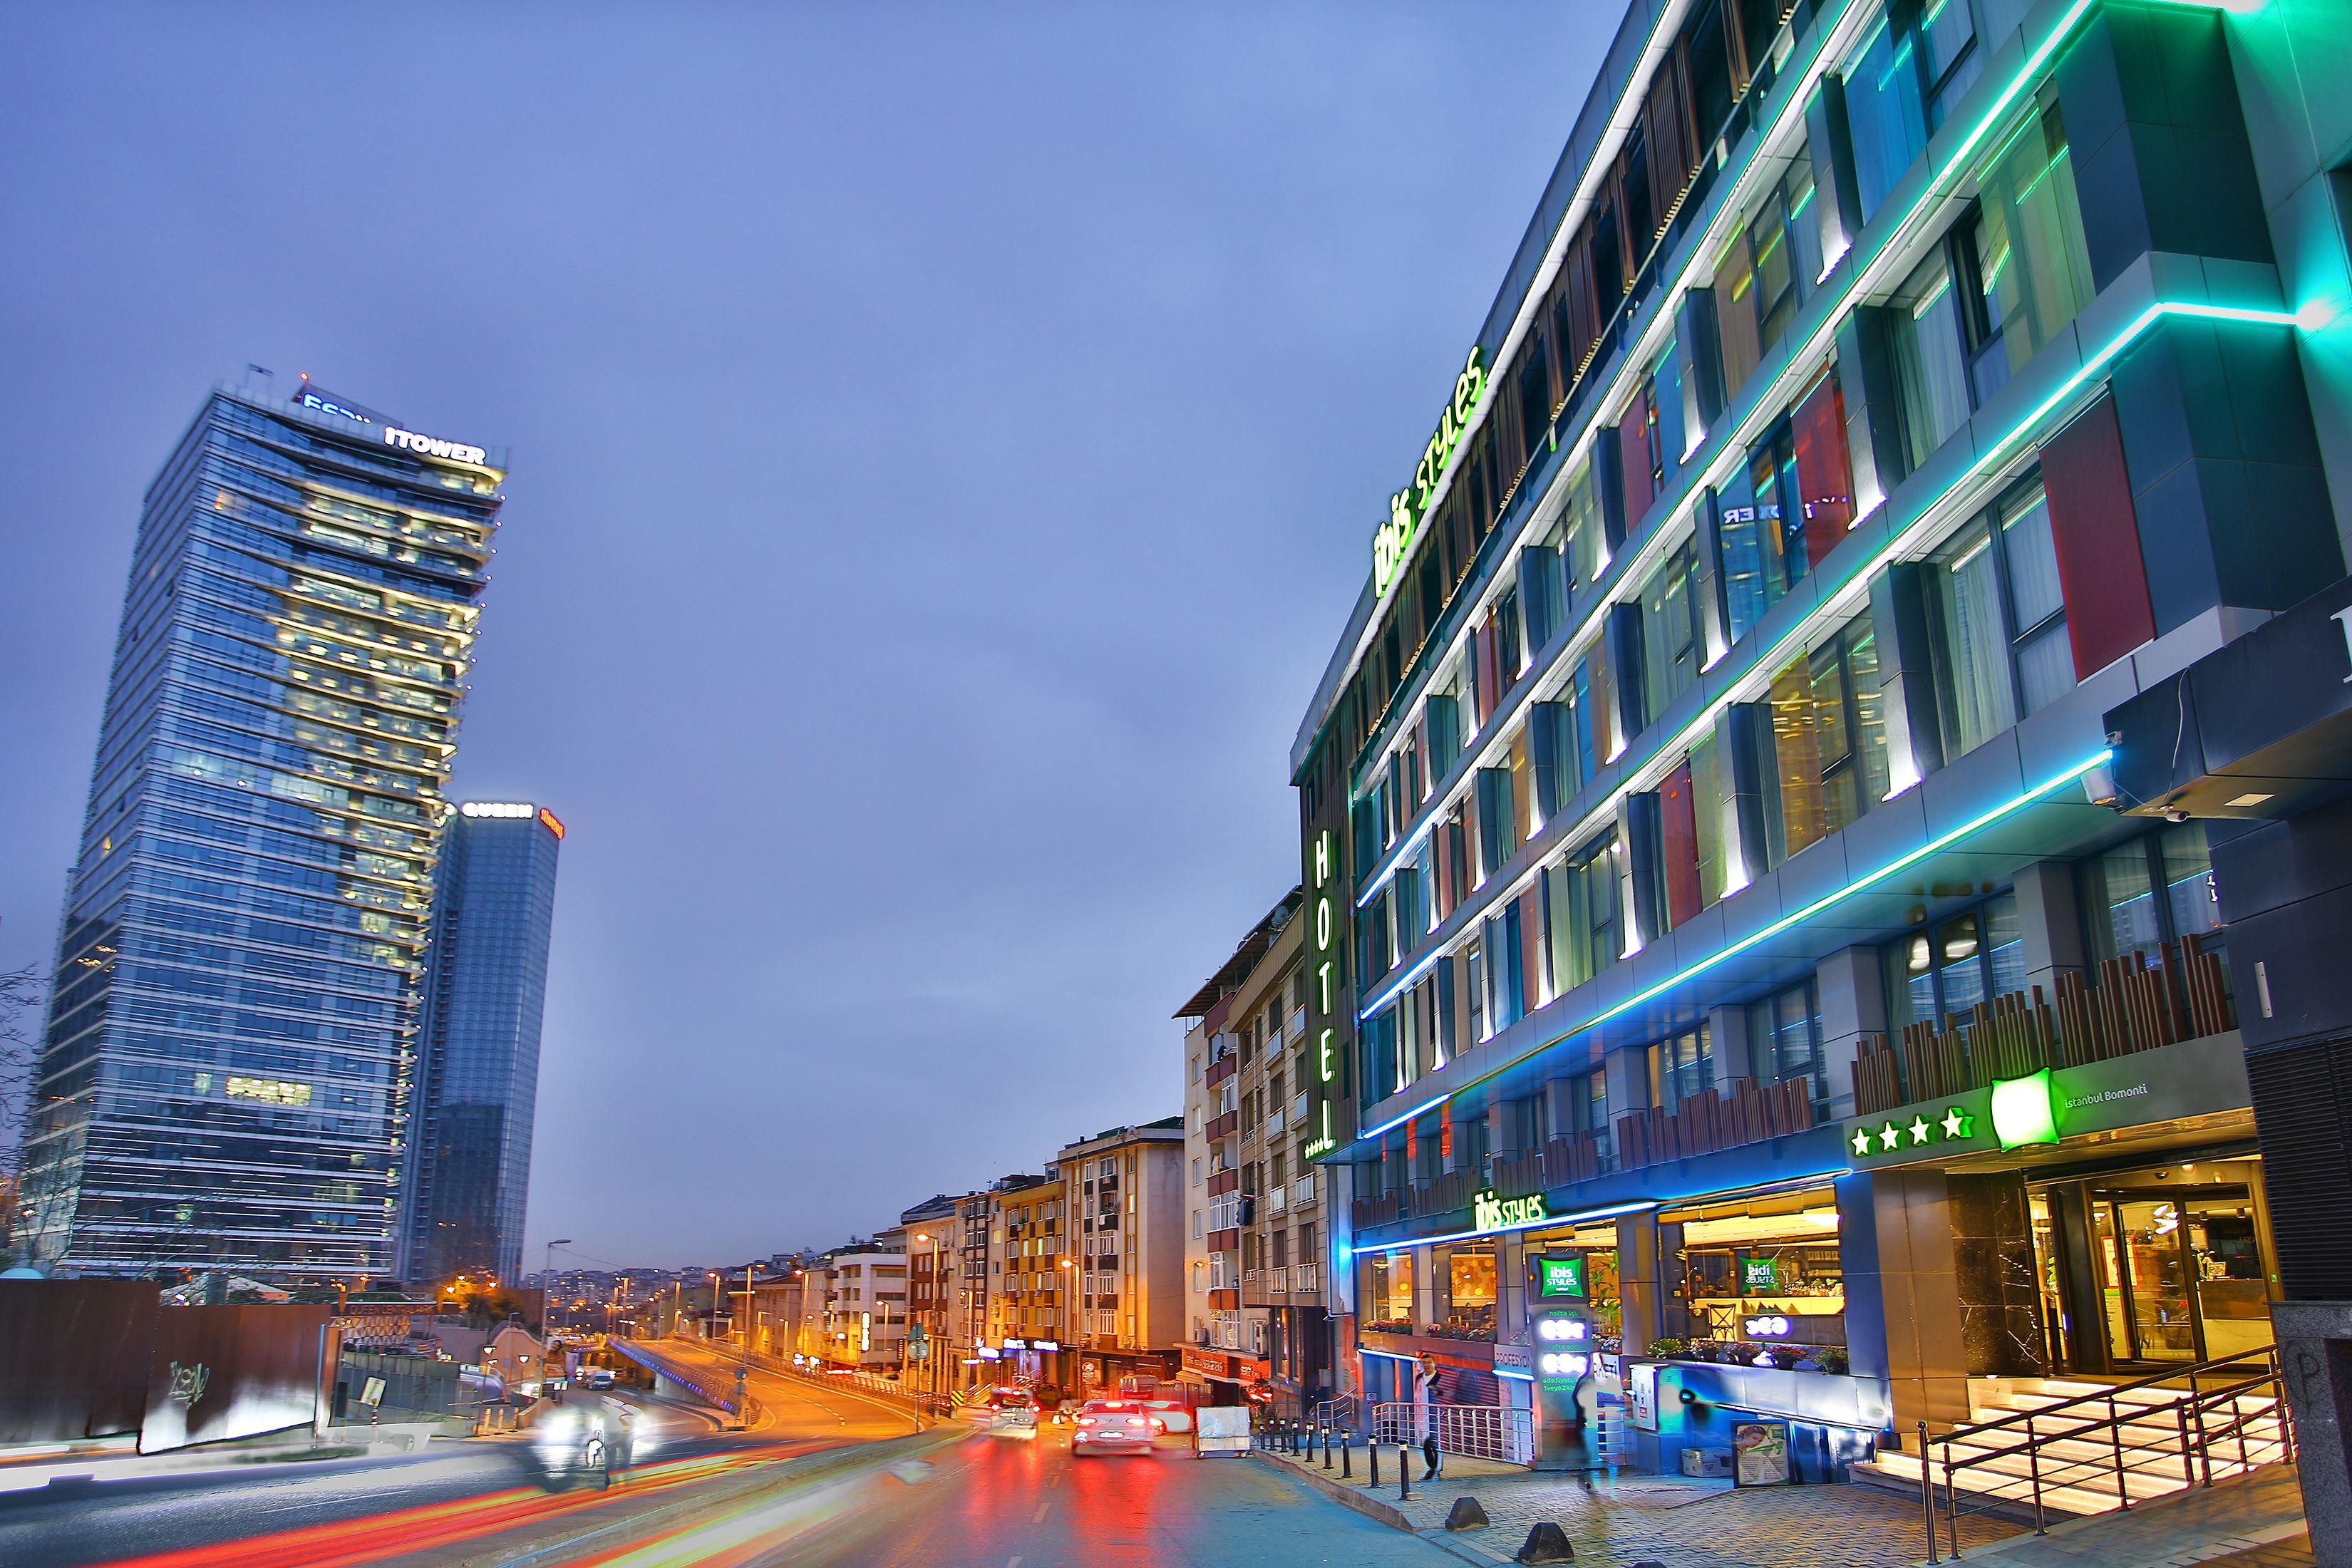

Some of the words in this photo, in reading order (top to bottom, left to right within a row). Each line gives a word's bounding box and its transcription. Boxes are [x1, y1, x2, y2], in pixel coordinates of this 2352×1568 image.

[1374, 488, 1414, 599] ibis
[1315, 829, 1335, 1150] HOTEL
[2104, 1083, 2147, 1100] Bomonti
[1475, 1190, 1502, 1231] ibis
[1549, 1266, 1574, 1278] ibis
[1496, 1352, 1531, 1368] PROFESYON
